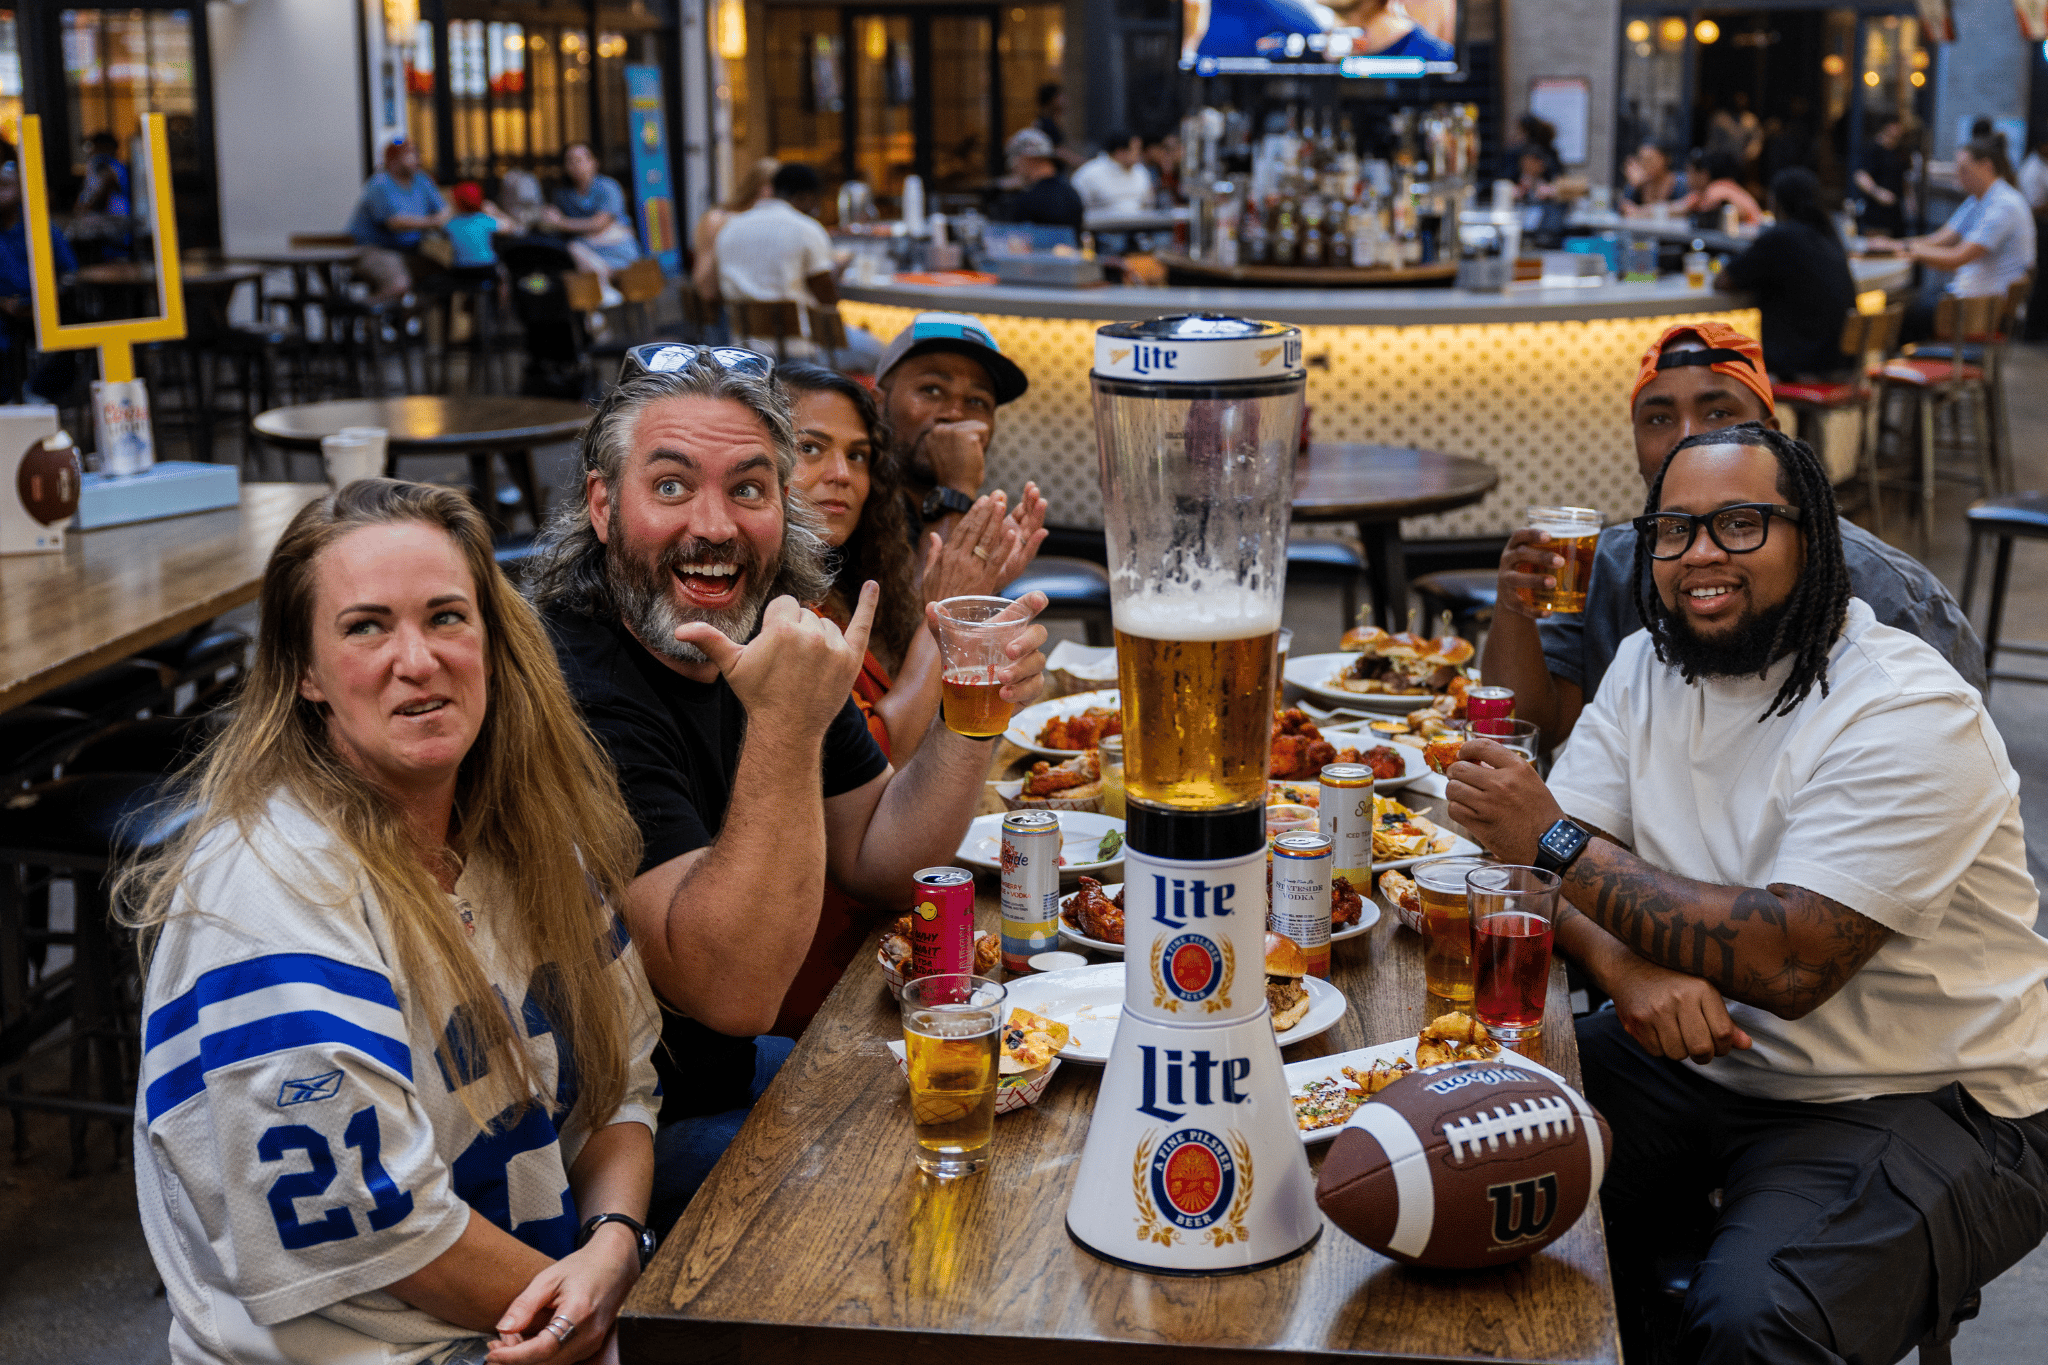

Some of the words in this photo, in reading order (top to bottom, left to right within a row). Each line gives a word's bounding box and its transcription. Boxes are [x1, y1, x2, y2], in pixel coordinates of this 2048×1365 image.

[1133, 344, 1178, 375] Lite
[1276, 881, 1323, 892] STATESIDE
[1282, 892, 1315, 901] VODKA
[1151, 873, 1235, 930] Lite
[1180, 991, 1206, 1001] BEER
[1136, 1045, 1250, 1123] Lite
[1423, 1068, 1537, 1095] Wilson
[1158, 1132, 1186, 1160] FINE
[1190, 1130, 1233, 1173] PILSNER
[256, 1105, 414, 1250] 21
[1154, 1161, 1164, 1172] A
[1175, 1214, 1213, 1227] BEER
